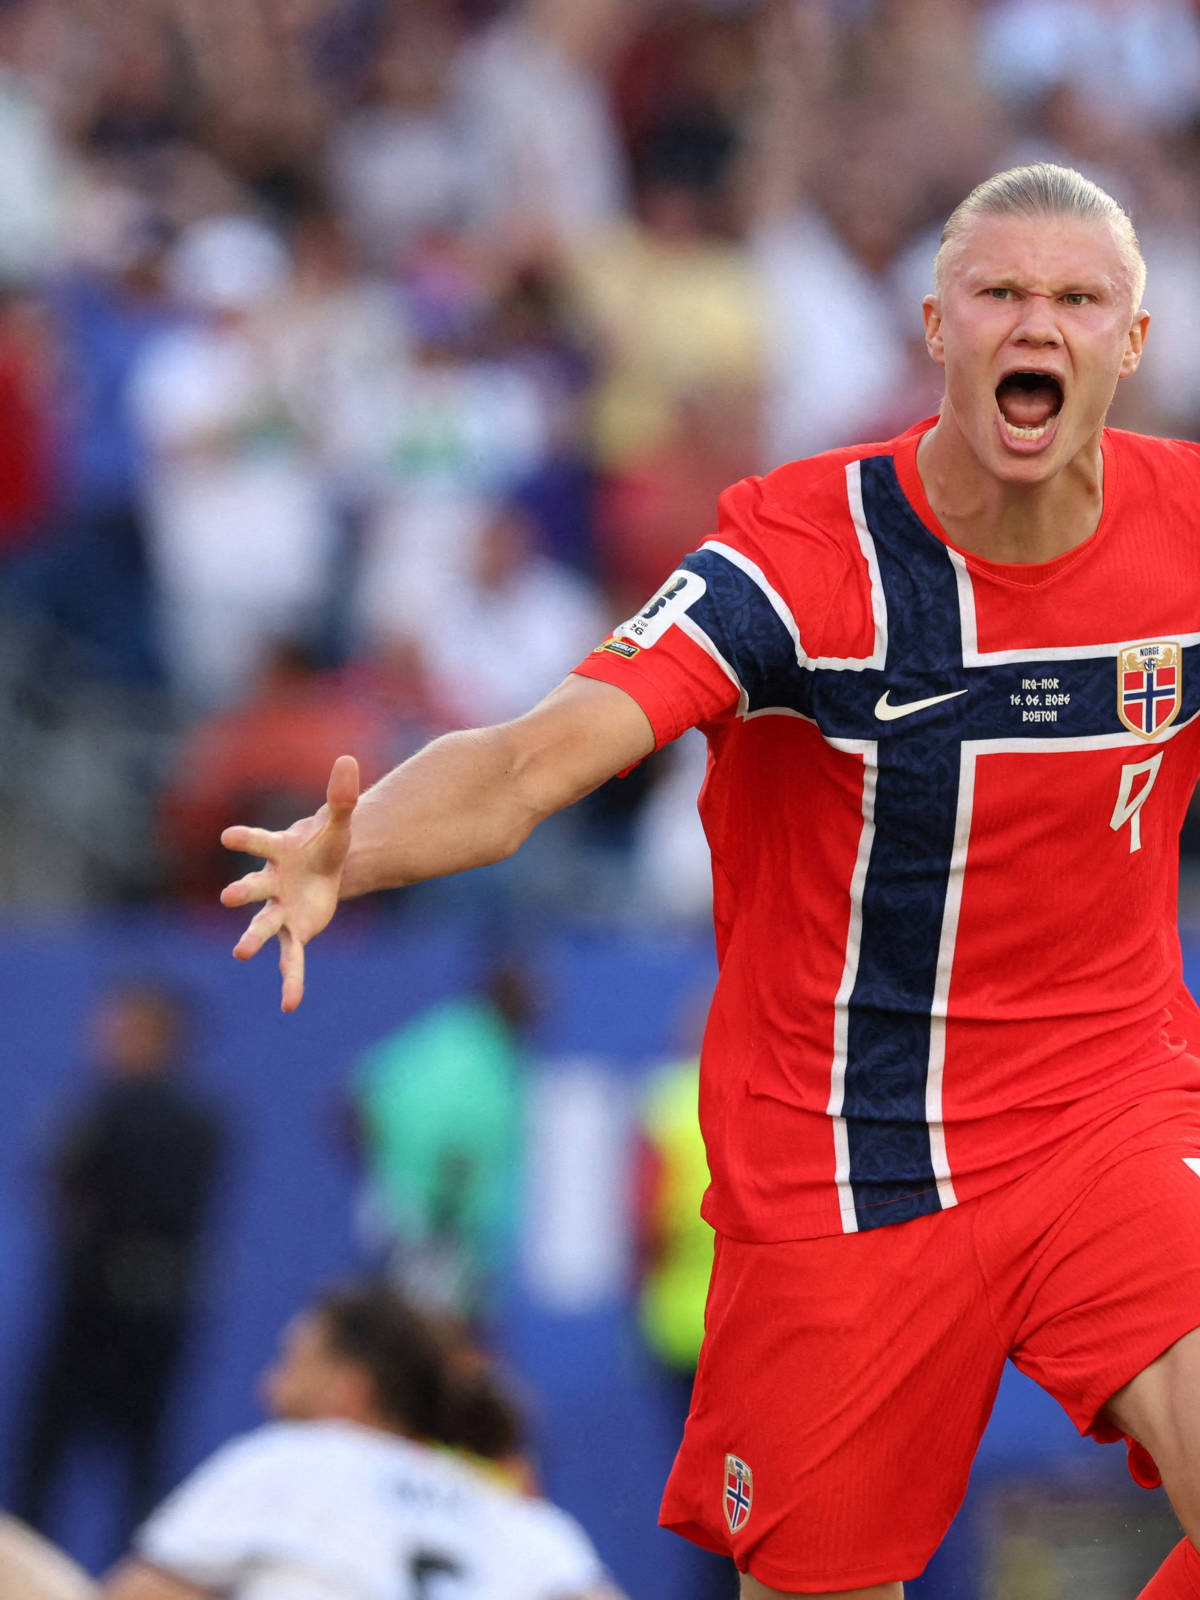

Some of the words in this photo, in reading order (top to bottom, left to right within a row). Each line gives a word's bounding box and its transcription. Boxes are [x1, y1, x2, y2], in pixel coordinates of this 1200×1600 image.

[1140, 646, 1160, 656] NORGE
[1022, 678, 1060, 690] IRQ-NOR
[1022, 710, 1058, 722] BOSTON
[1109, 751, 1165, 854] 9
